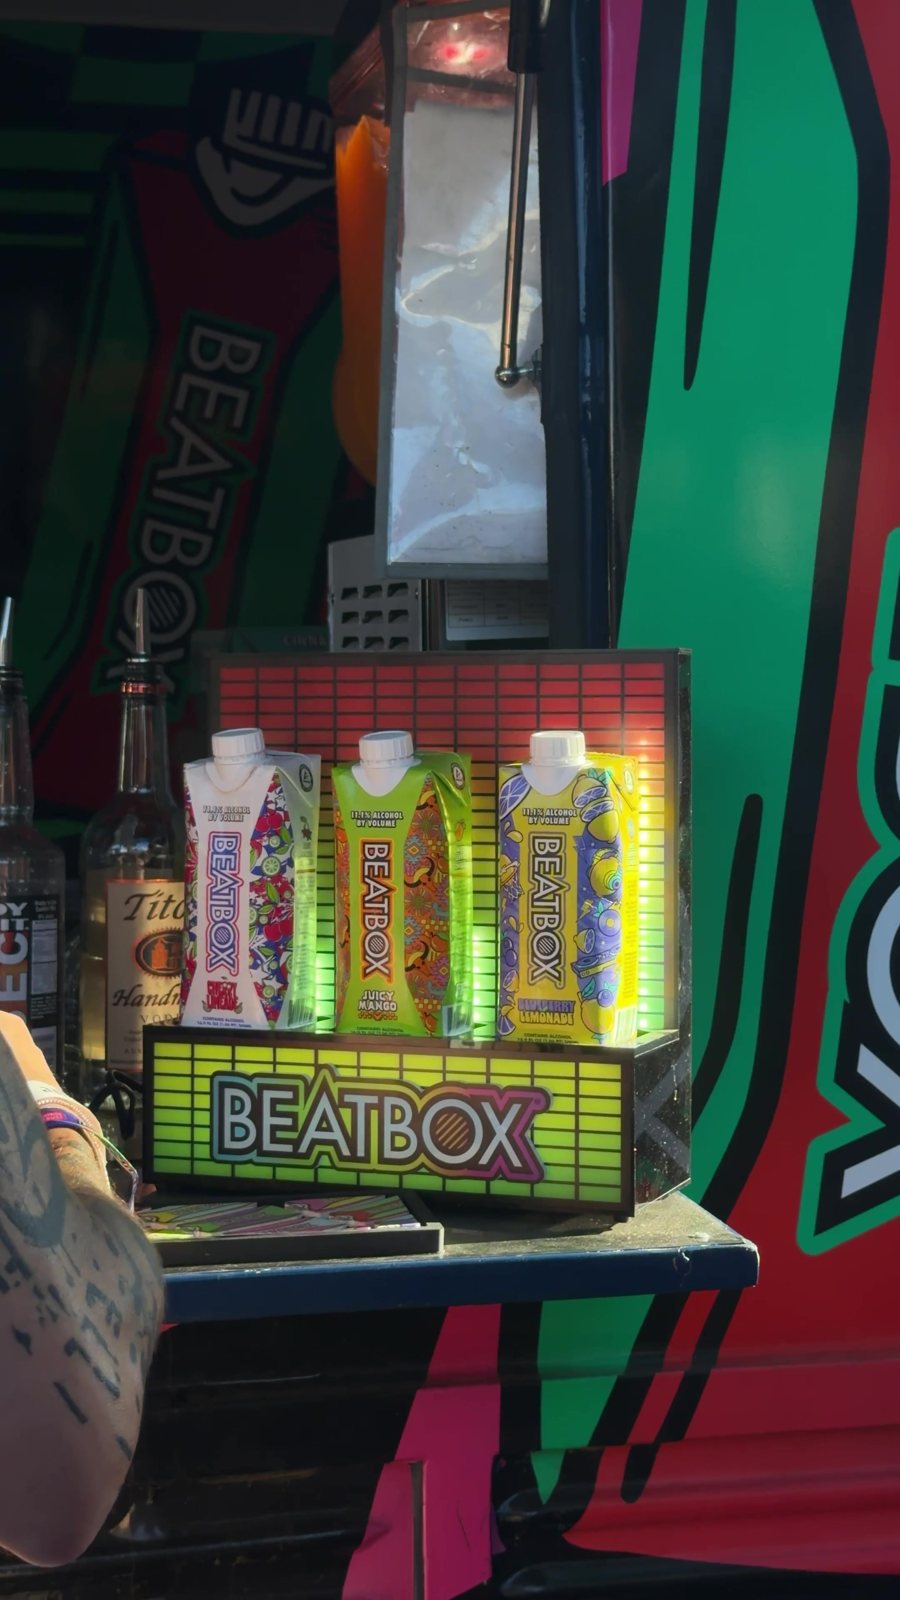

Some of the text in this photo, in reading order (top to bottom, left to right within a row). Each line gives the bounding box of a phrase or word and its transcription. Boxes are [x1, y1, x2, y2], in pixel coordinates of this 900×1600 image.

[107, 324, 262, 692] BEATBOX
[224, 806, 250, 814] ALCOHOL
[351, 810, 403, 819] 11.1% ALCOHOL
[522, 808, 578, 817] 11.1% ALCOHOL
[220, 814, 244, 822] VOLUME
[356, 819, 397, 828] BY VOLUME
[528, 816, 570, 825] BY VOLUME
[208, 833, 239, 974] BEATBOX
[361, 840, 392, 979] BEATBOX
[530, 835, 564, 984] BEATBOX
[362, 990, 395, 1001] JUICY
[358, 1000, 398, 1011] MANGO
[518, 998, 576, 1012] BLUEBERRY
[520, 1011, 574, 1025] LEMONADE
[221, 1085, 525, 1169] BEATBOX
